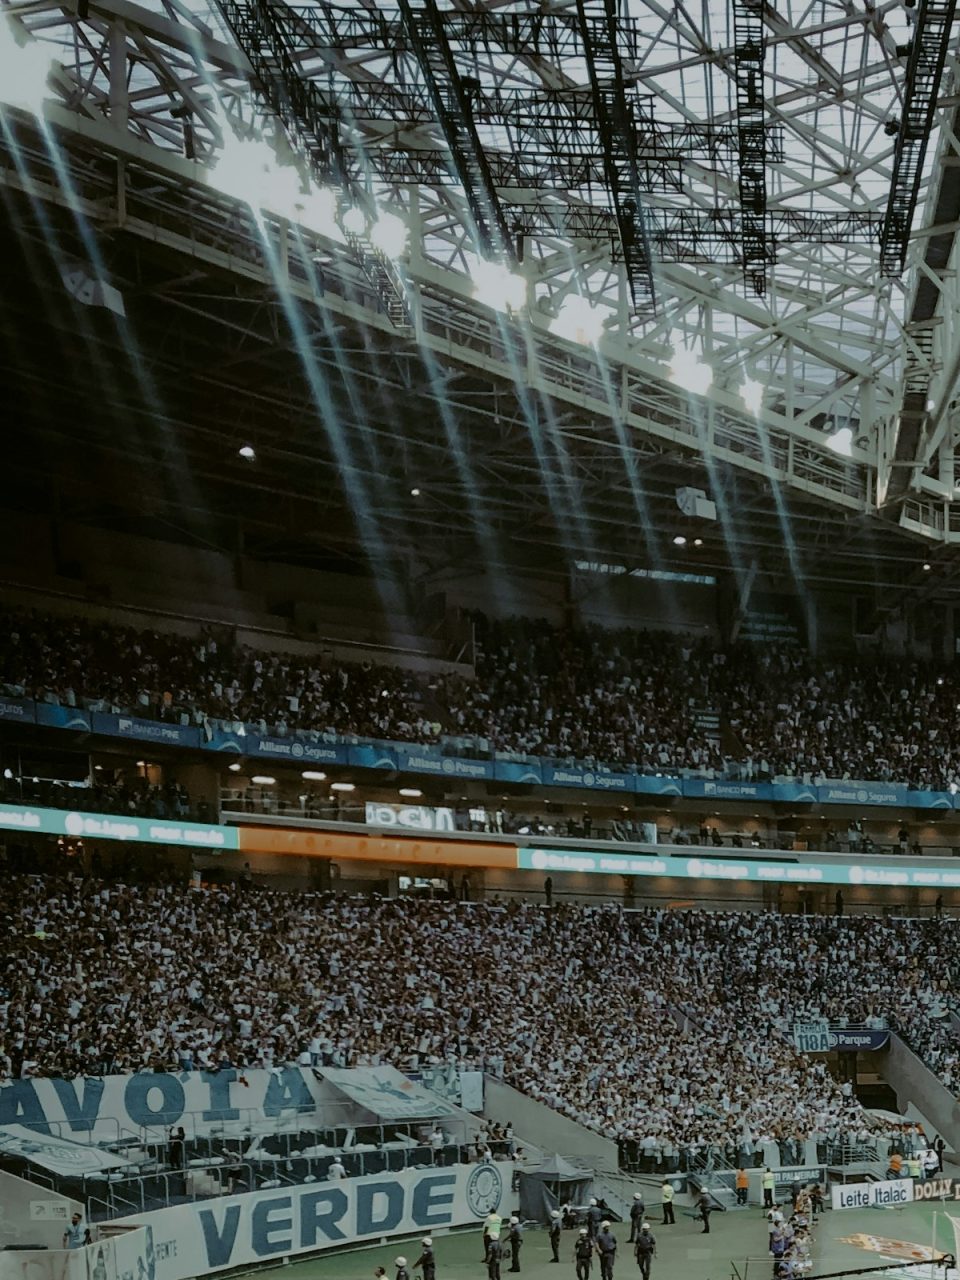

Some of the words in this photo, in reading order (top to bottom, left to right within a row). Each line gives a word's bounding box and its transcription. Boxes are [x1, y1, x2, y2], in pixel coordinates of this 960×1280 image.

[259, 741, 290, 754] Allianz
[303, 745, 337, 759] Seguros
[408, 757, 441, 770] Allianz
[455, 762, 486, 776] Parque
[553, 771, 583, 783] Allianz
[595, 775, 626, 788] Seguros
[828, 790, 857, 801] Allianz
[868, 792, 897, 803] Seguros
[839, 1034, 871, 1046] Parque
[841, 1191, 869, 1208] Leite
[875, 1186, 907, 1204] Italac
[915, 1178, 953, 1200] DOLLY
[198, 1174, 457, 1269] VERDE
